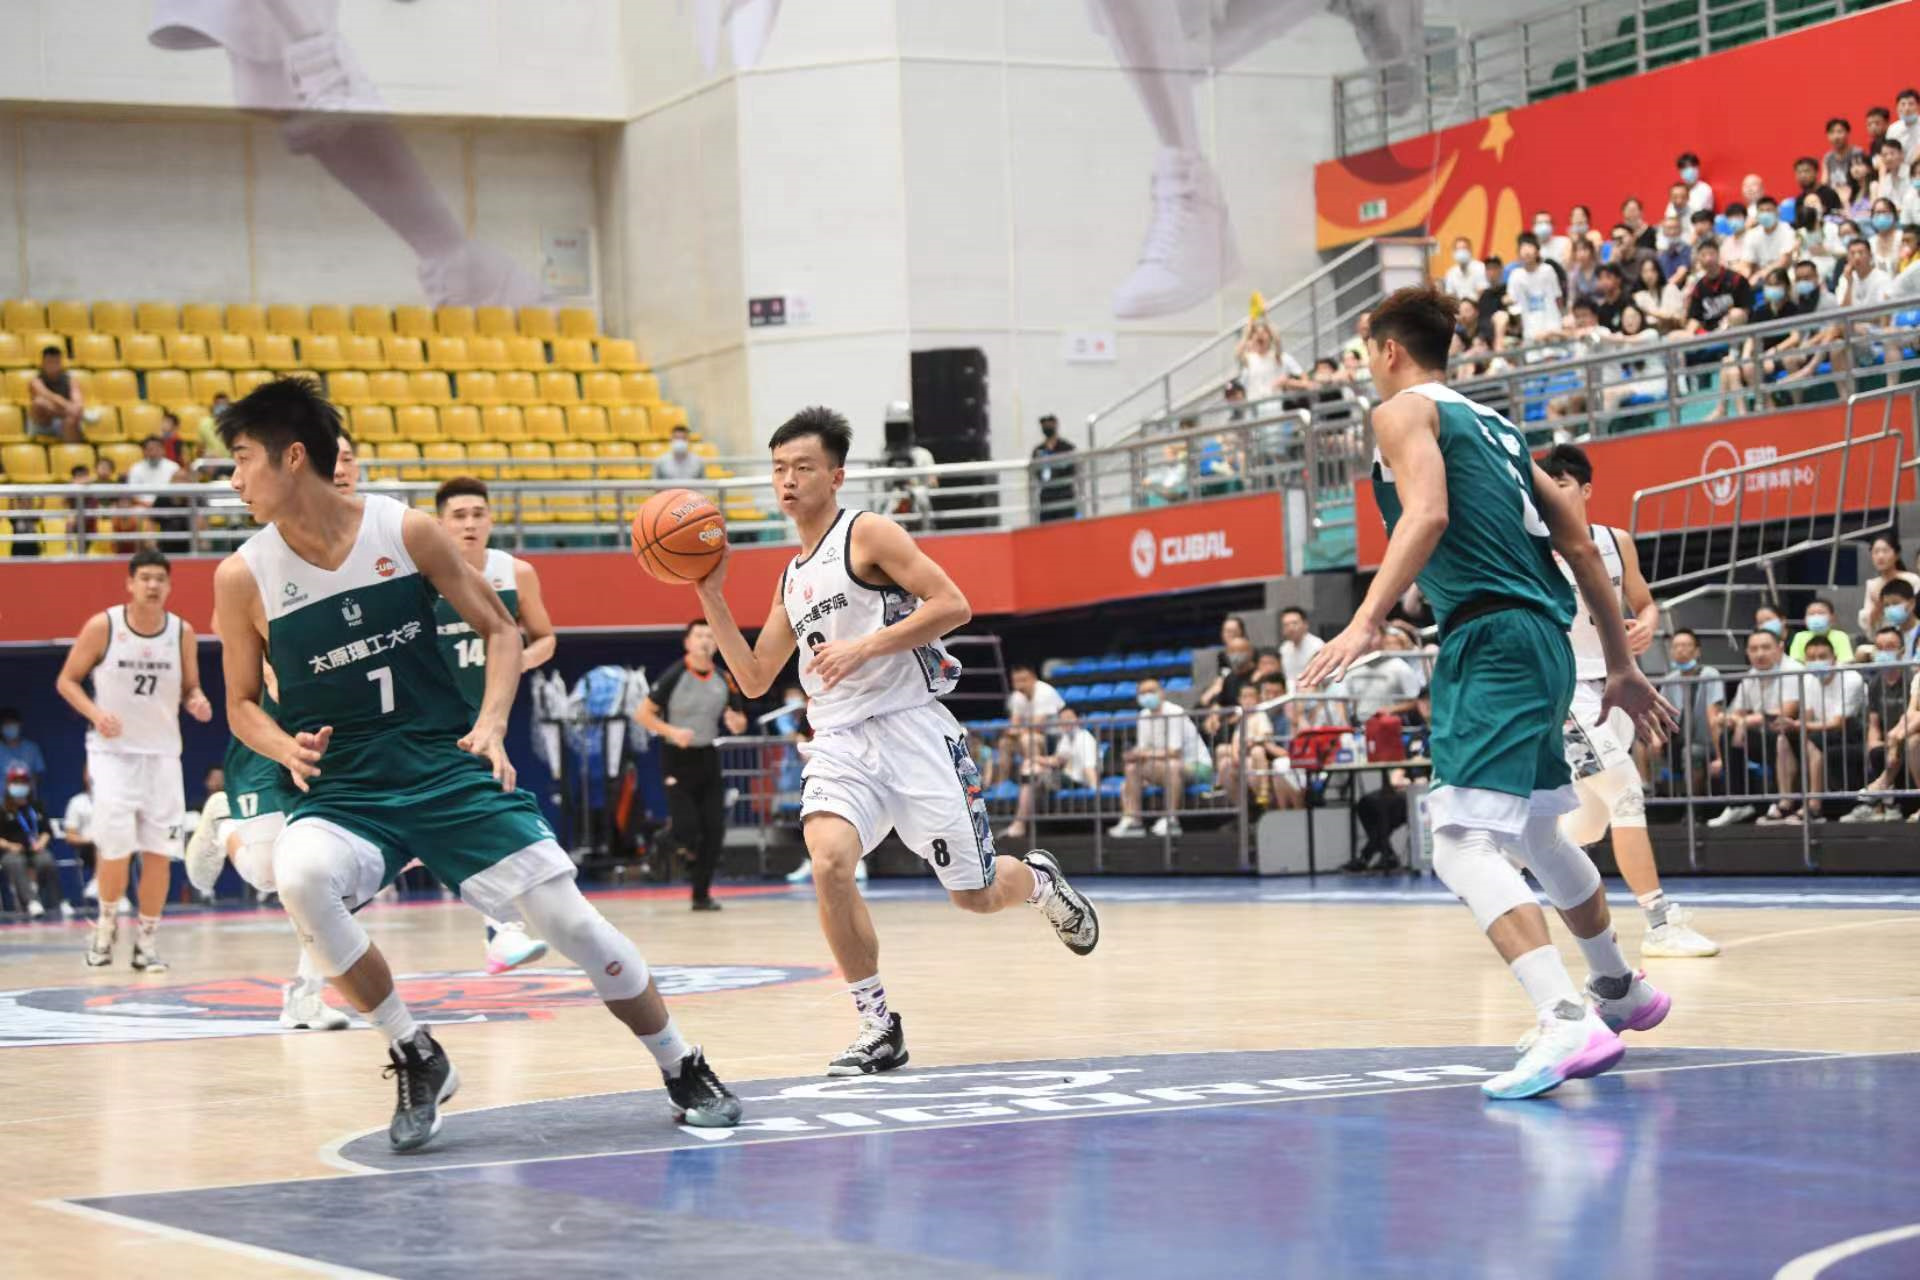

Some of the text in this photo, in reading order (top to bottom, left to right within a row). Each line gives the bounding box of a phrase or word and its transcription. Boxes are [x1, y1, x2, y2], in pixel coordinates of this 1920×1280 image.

[1161, 530, 1234, 566] CUBAL
[307, 620, 423, 674] 太原理工大学
[453, 638, 486, 668] 14
[134, 673, 158, 696] 27
[366, 665, 395, 714] 7
[237, 792, 259, 818] 17
[931, 838, 951, 867] 8
[678, 1064, 1502, 1140] RIGORER
